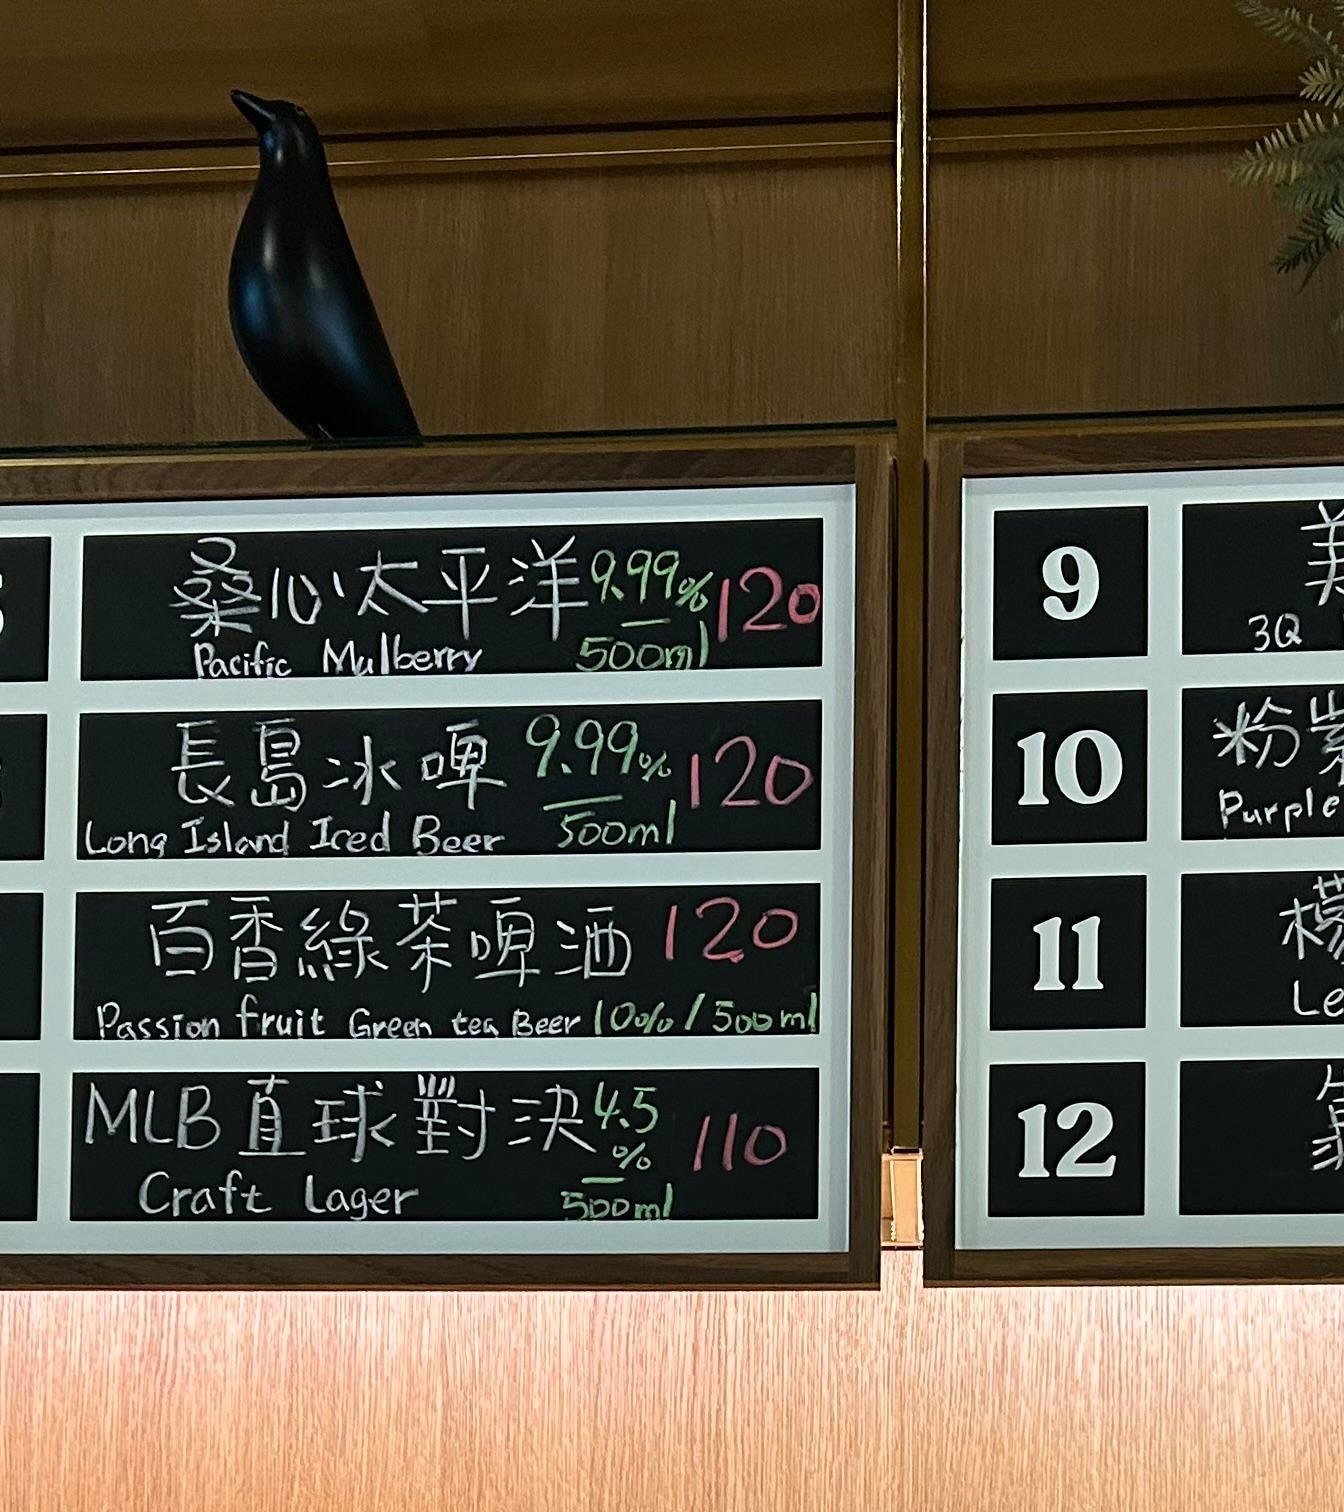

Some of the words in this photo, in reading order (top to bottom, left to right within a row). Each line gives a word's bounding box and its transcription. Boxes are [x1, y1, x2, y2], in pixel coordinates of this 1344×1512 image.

[719, 567, 820, 640] 120
[1043, 546, 1099, 620] 9
[194, 641, 291, 677] Pacific
[323, 640, 484, 674] Mulberry
[575, 624, 709, 672] 500ml
[1249, 613, 1302, 651] 3Q
[526, 715, 671, 782] 9.99%
[691, 736, 811, 808] 120
[1017, 730, 1122, 805] 10
[86, 821, 167, 857] Long
[182, 817, 289, 855] Island
[310, 811, 390, 852] Iced
[413, 815, 504, 855] Beer
[558, 800, 676, 848] 500ml
[1219, 788, 1339, 832] Purple
[150, 891, 631, 993] 百香綠茶啤酒
[666, 897, 797, 962] 120
[1033, 916, 1103, 990] 11
[97, 1000, 220, 1040] Passion
[236, 994, 325, 1037] fruit
[348, 1006, 433, 1039] Green
[452, 1012, 499, 1036] tea
[512, 1009, 581, 1036] Beer
[694, 1114, 785, 1170] 110
[1018, 1102, 1116, 1177] 12
[140, 1170, 271, 1216] Craft
[306, 1175, 418, 1214] Lager
[561, 1183, 672, 1218] 500ml
